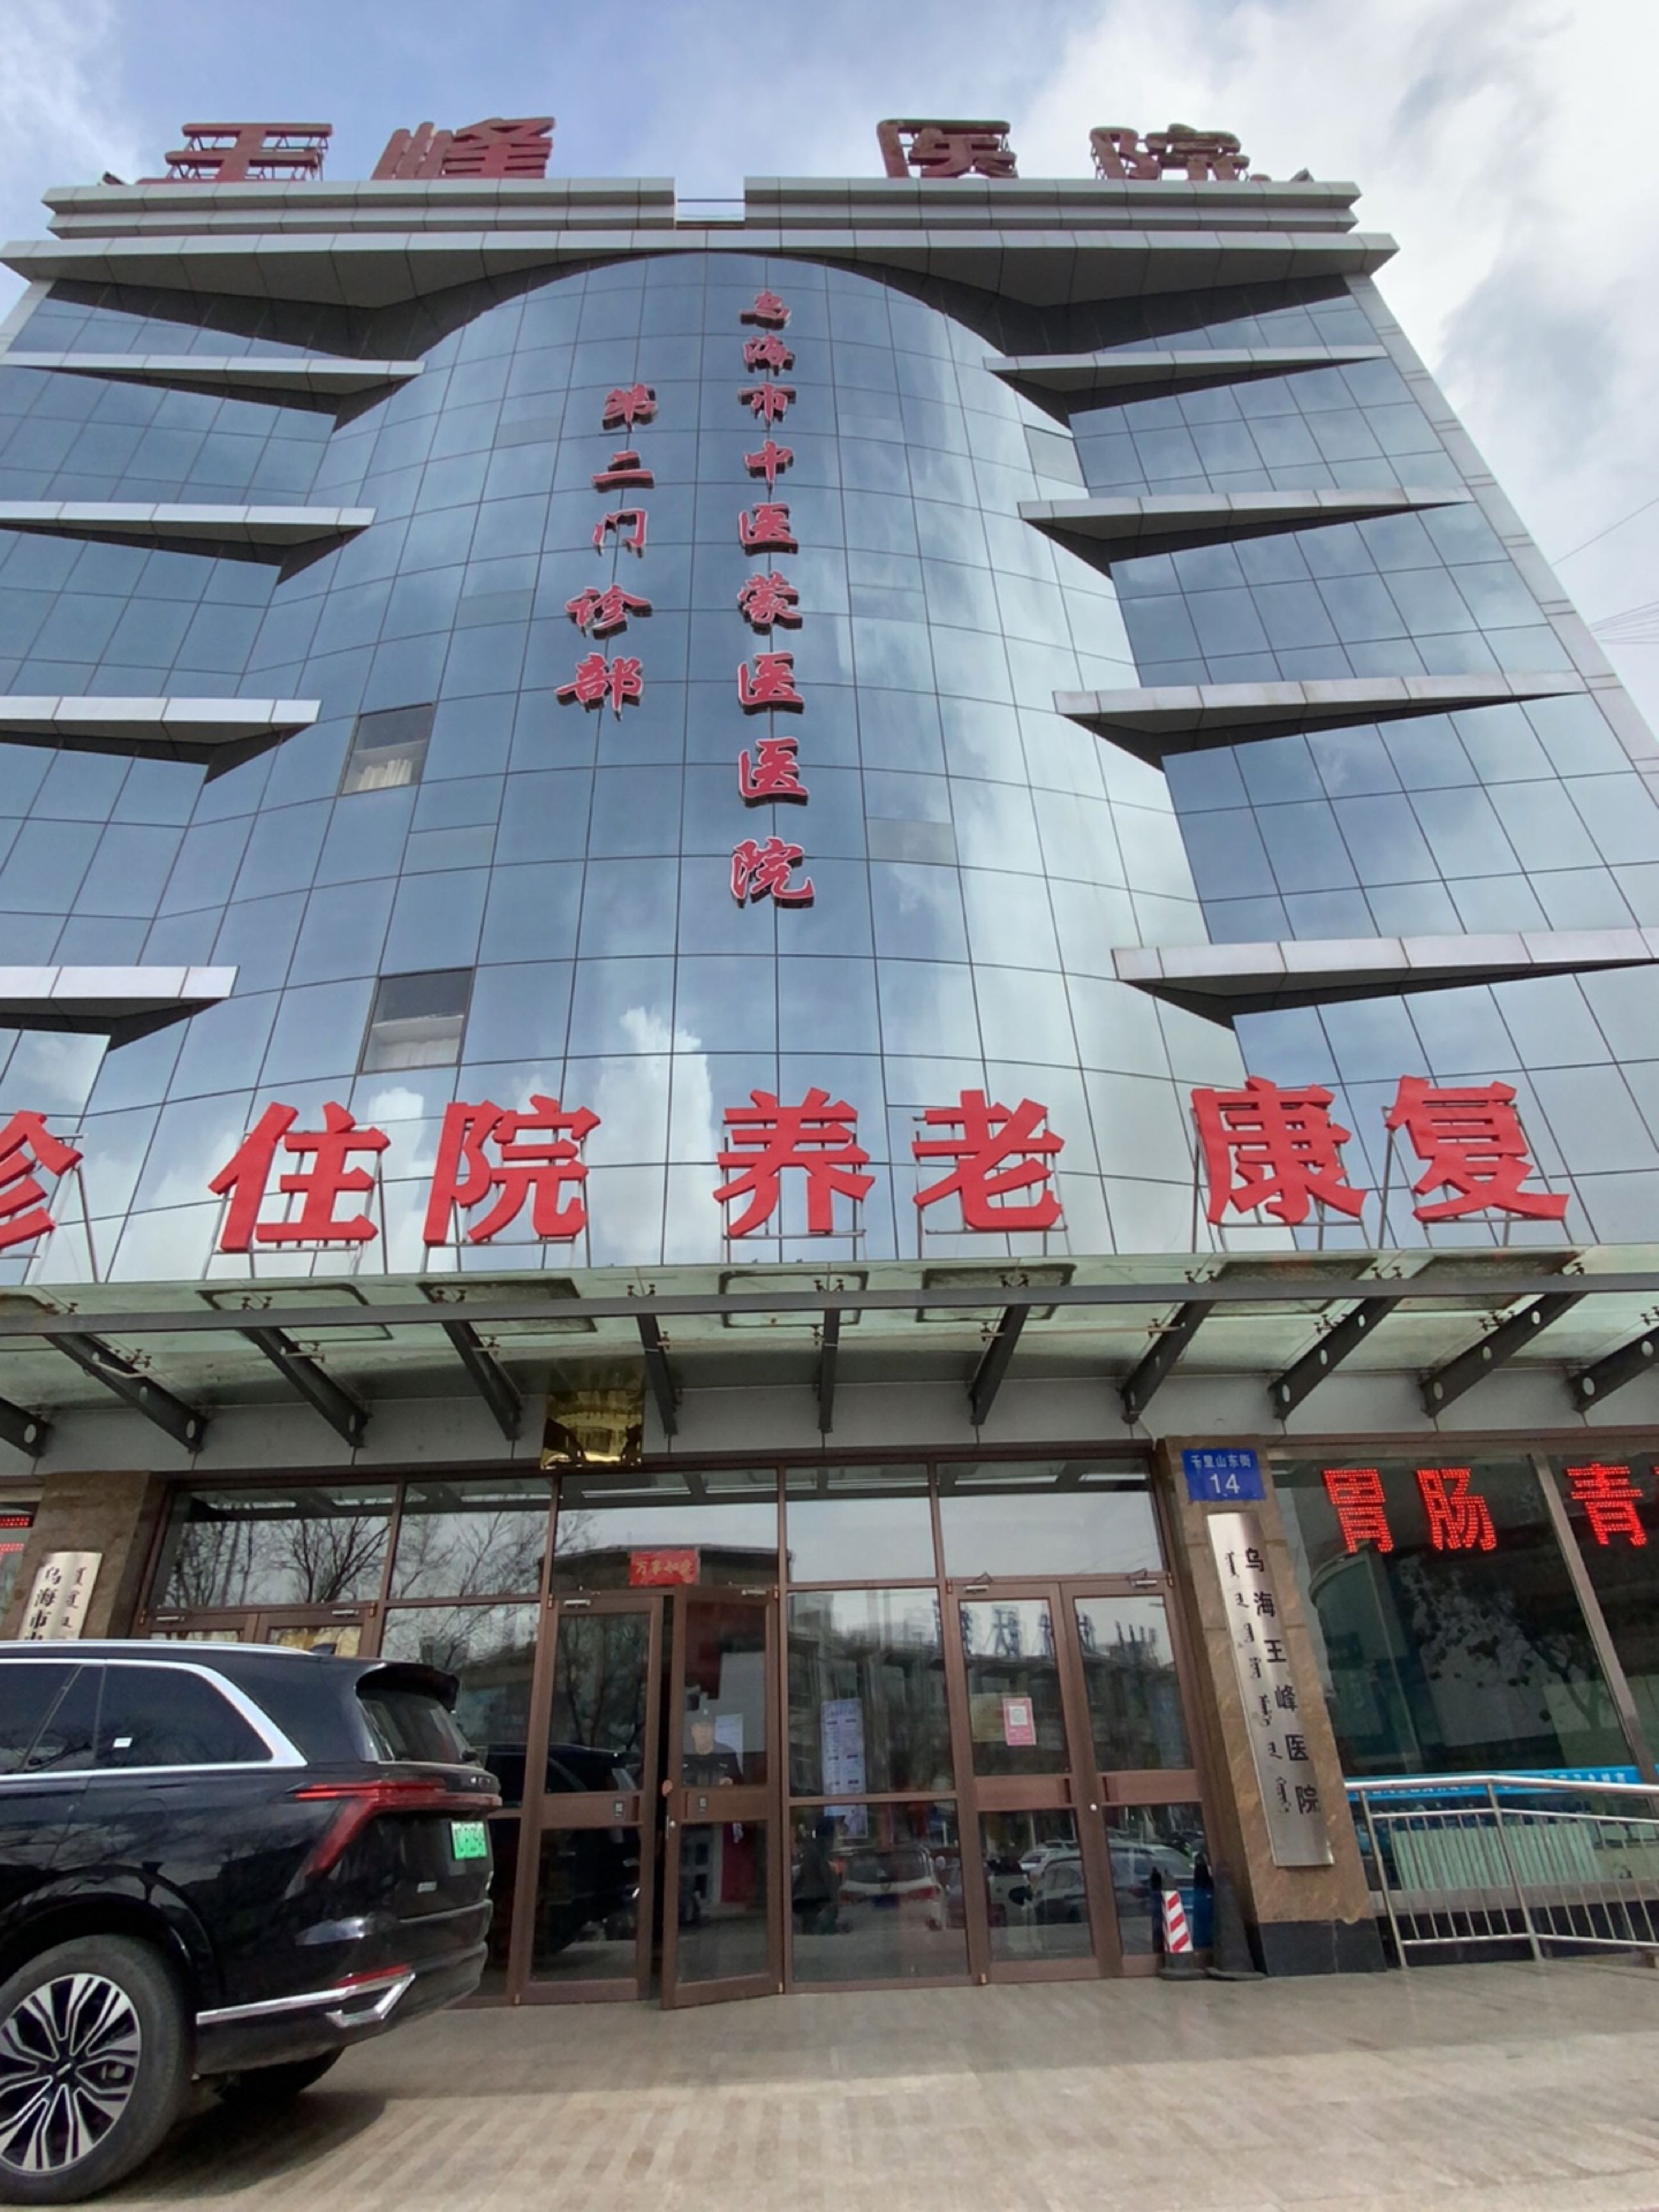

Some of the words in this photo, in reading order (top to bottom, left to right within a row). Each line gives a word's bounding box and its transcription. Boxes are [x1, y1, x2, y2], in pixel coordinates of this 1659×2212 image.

[555, 383, 656, 718] 第二门诊部
[730, 290, 815, 908] 乌海市中医蒙医医院
[207, 1094, 602, 1253] 住院
[712, 1087, 1068, 1240] 养老
[1191, 1076, 1568, 1224] 康复
[1210, 1473, 1240, 1495] 14
[1323, 1468, 1497, 1553] 胃肠
[1566, 1463, 1659, 1546] 青
[1245, 1547, 1323, 1815] 乌海王峰医院
